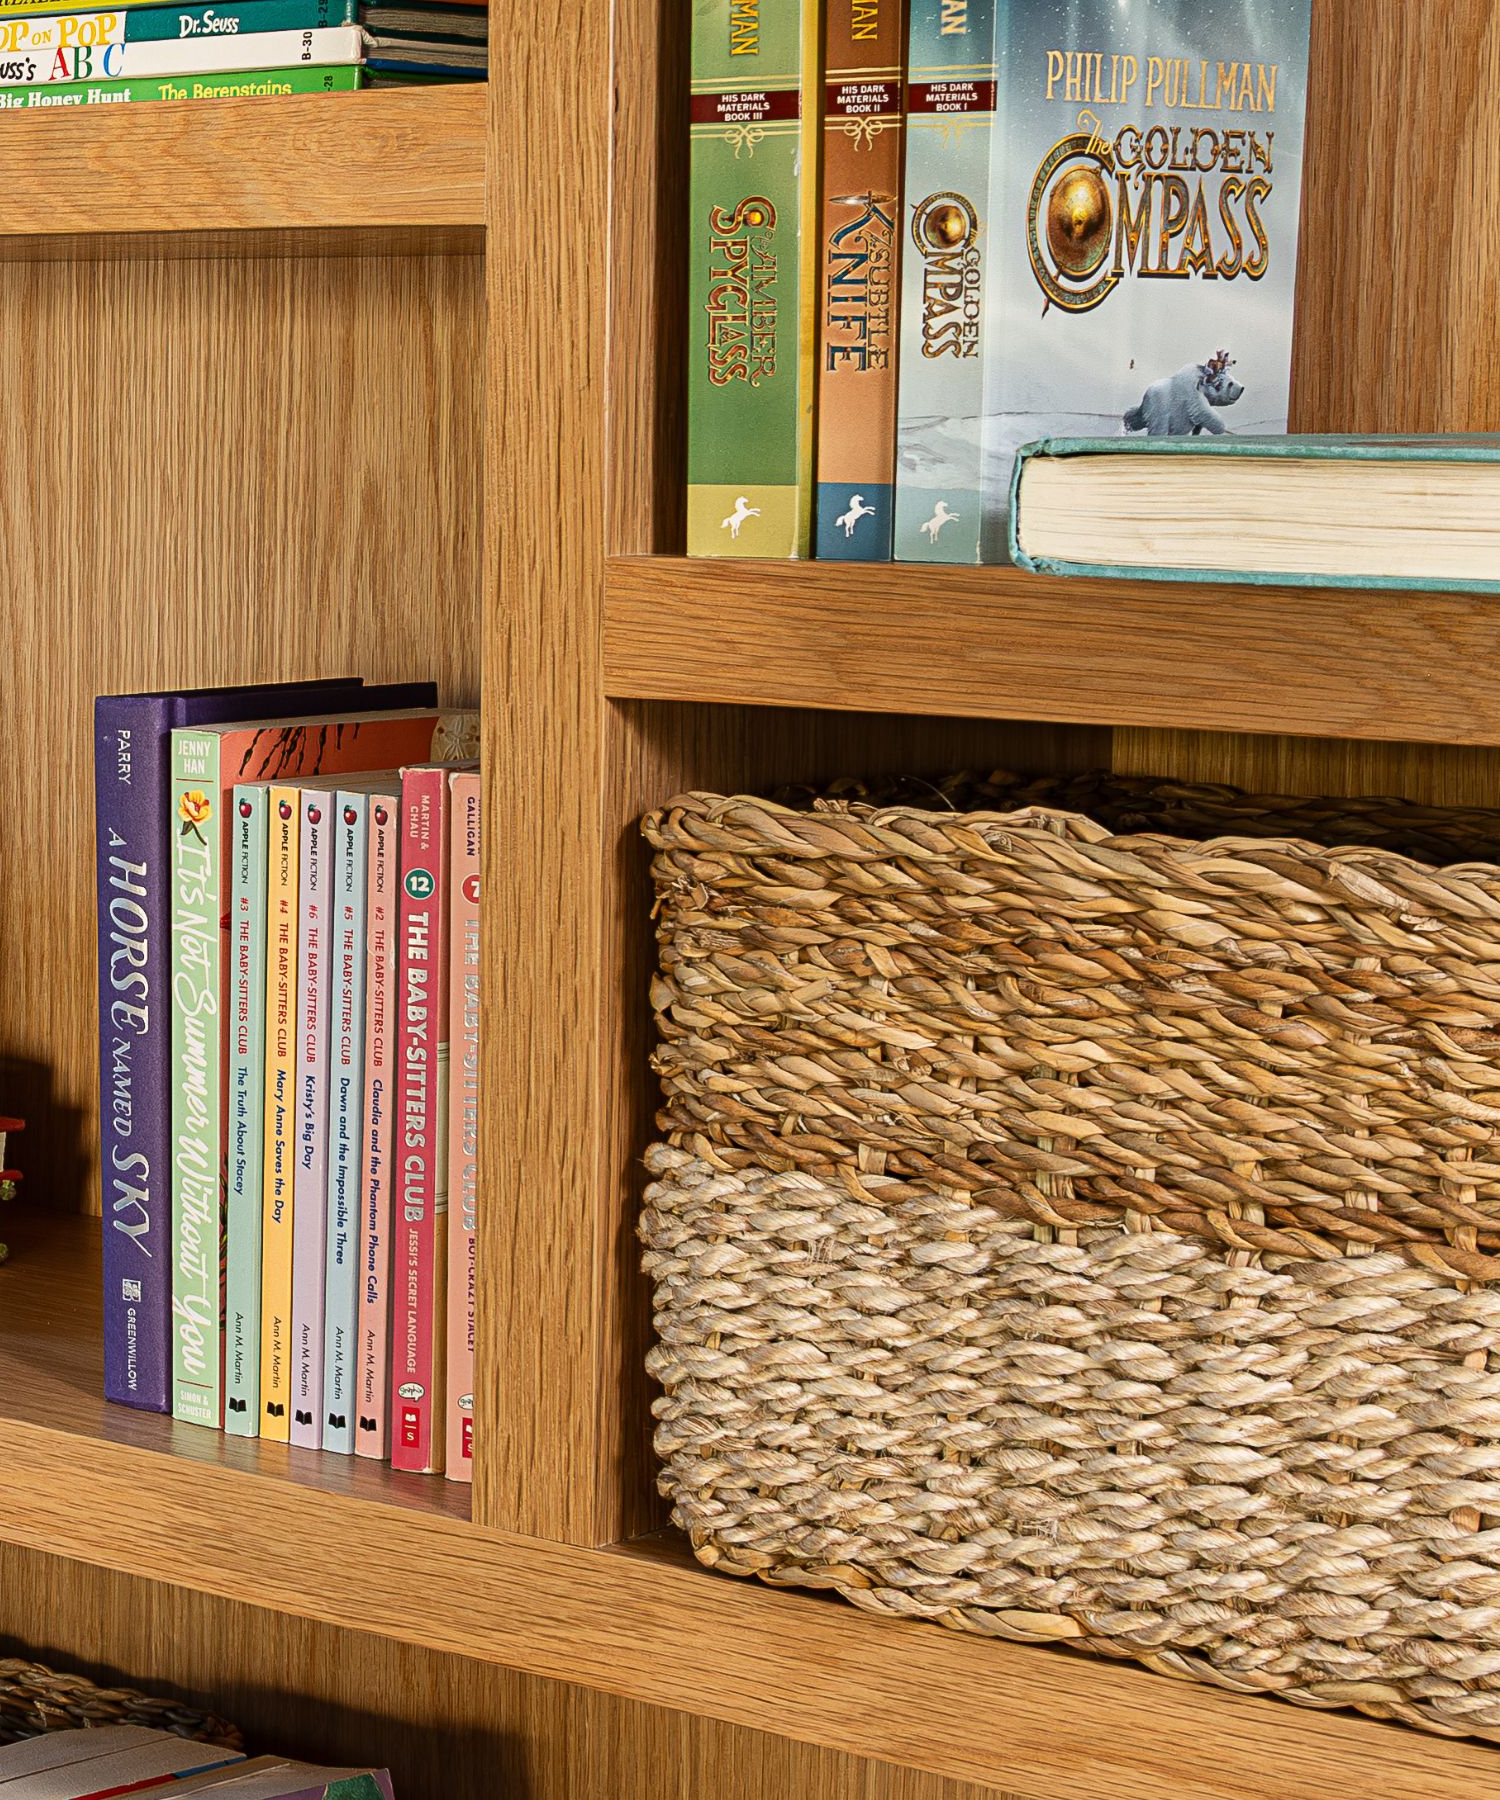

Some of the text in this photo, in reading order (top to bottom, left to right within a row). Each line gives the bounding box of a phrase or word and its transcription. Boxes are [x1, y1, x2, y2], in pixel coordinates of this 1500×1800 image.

[300, 31, 312, 61] B-30
[1045, 49, 1278, 112] PHILIP PULLMAN
[117, 729, 131, 785] PARRY
[178, 741, 211, 757] JENNY
[183, 758, 205, 775] HAN
[241, 820, 249, 885] APPLE FICTION
[110, 855, 150, 1035] HORSE
[238, 920, 249, 1055] THE BABY-SITTERS CLUB
[112, 1146, 152, 1258] SKY
